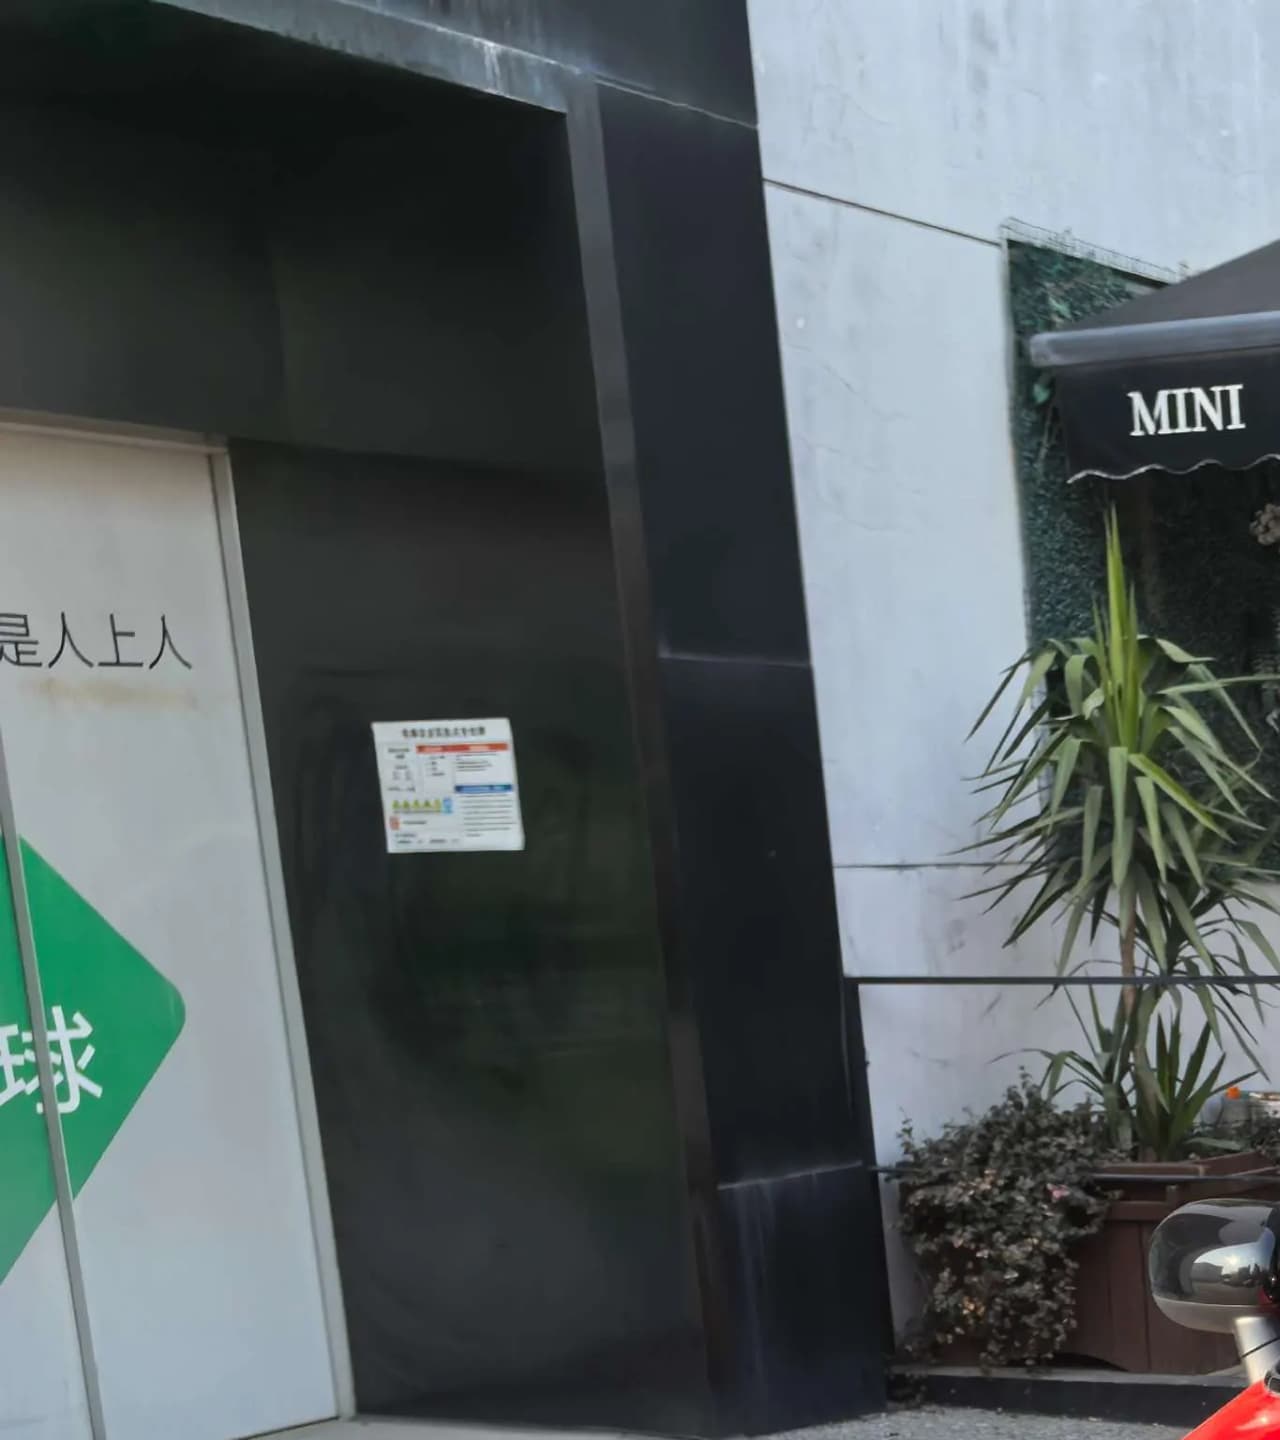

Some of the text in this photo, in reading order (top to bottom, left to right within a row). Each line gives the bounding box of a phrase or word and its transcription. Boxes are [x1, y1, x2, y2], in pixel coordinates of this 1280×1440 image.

[1127, 383, 1246, 437] MINI
[0, 611, 192, 670] 是人上人
